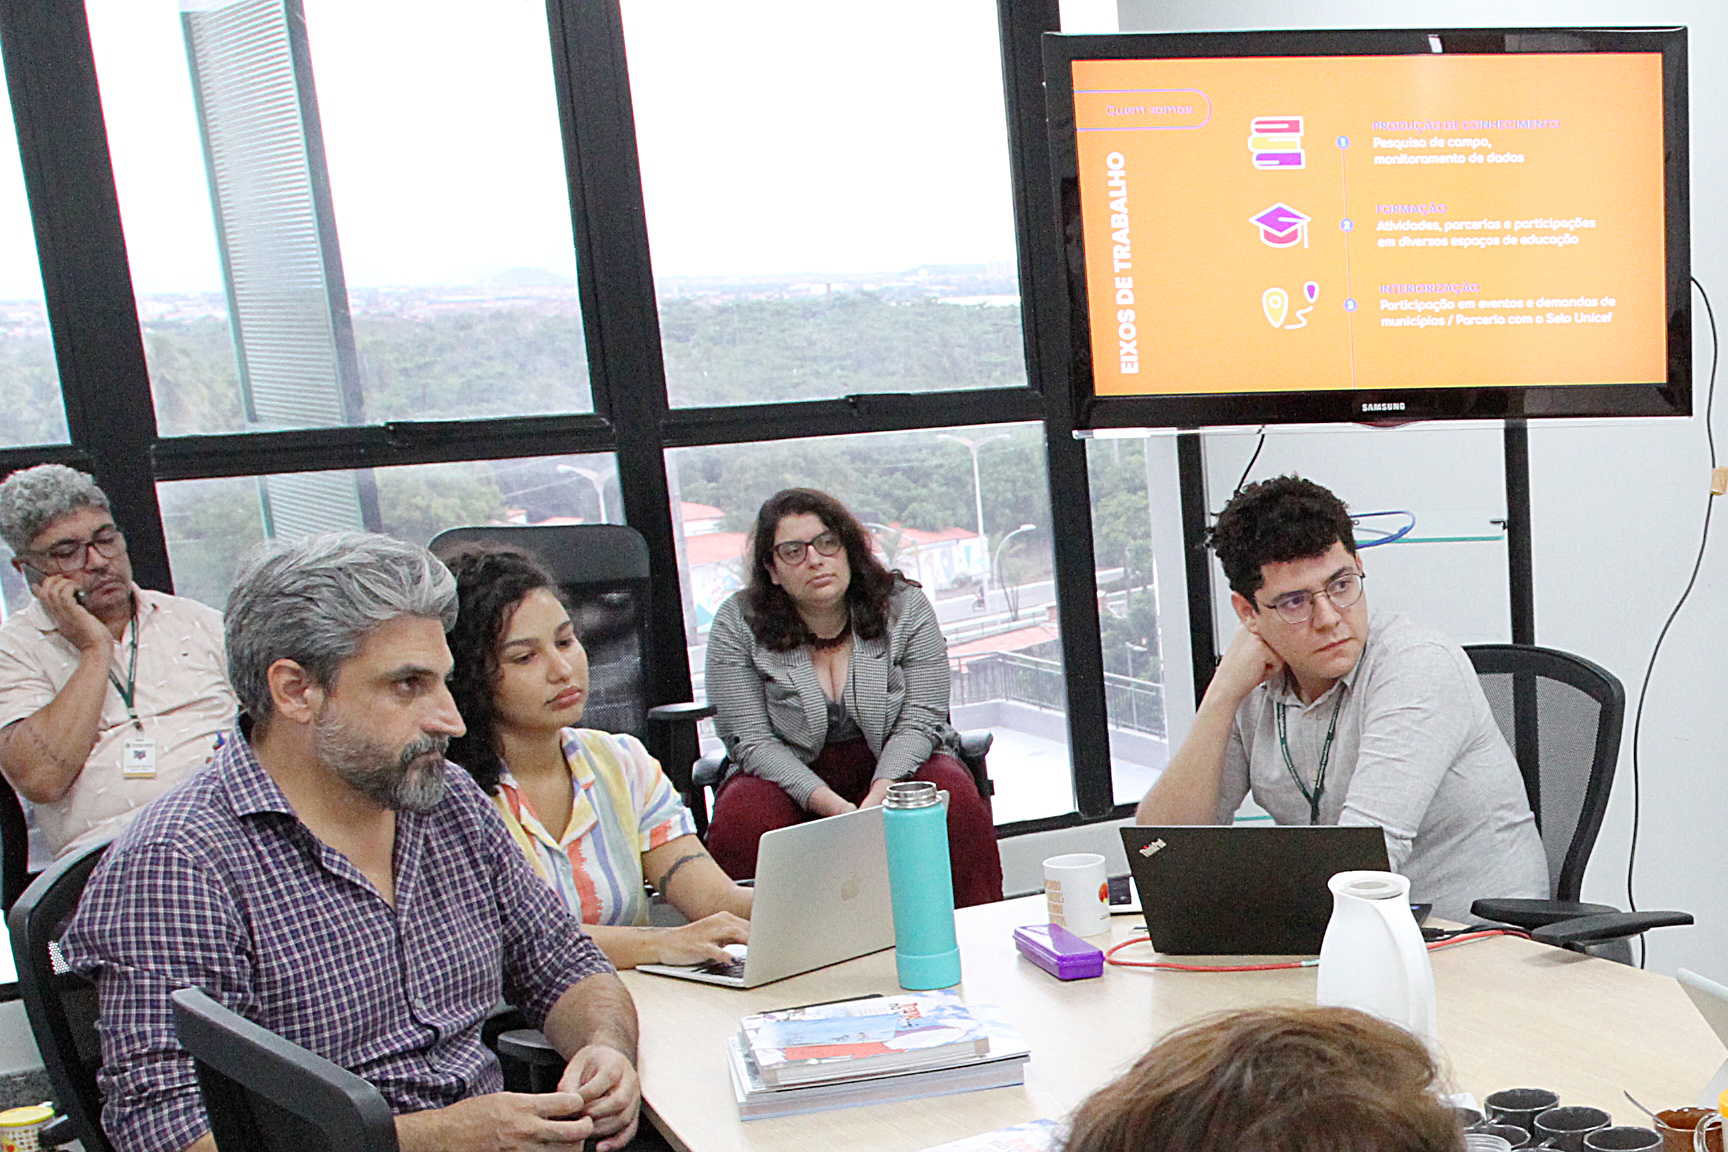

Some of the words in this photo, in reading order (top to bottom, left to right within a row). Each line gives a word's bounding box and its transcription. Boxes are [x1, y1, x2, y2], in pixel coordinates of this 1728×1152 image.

[1106, 104, 1146, 117] Quem
[1150, 104, 1194, 115] somos
[1372, 119, 1442, 133] PRODUÇÃO
[1444, 120, 1460, 131] DE
[1462, 119, 1561, 130] CONHECIMENTO
[1372, 136, 1427, 150] Pesquisa
[1429, 136, 1445, 148] de
[1448, 137, 1492, 149] campo,
[1374, 153, 1467, 165] monitoramento
[1468, 152, 1485, 164] de
[1486, 152, 1525, 164] dados
[1106, 151, 1132, 273] TRABALHO
[1376, 202, 1448, 217] FORMAÇÃO
[1376, 219, 1443, 233] Atividades,
[1444, 219, 1502, 232] parcerias
[1504, 220, 1512, 230] e
[1514, 217, 1597, 231] participações
[1377, 238, 1396, 248] em
[1398, 236, 1449, 247] diversos
[1450, 236, 1501, 249] espaços
[1502, 234, 1518, 246] de
[1520, 233, 1579, 247] educação
[1114, 276, 1135, 305] DE
[1379, 281, 1480, 296] INTERIORIZAÇÃO
[1379, 298, 1456, 313] Participação
[1458, 300, 1476, 310] em
[1478, 298, 1524, 310] eventos
[1526, 299, 1535, 309] e
[1536, 296, 1599, 309] demandas
[1600, 296, 1617, 308] de
[1380, 314, 1446, 328] municípios
[1448, 314, 1455, 327] /
[1456, 314, 1506, 326] Parceria
[1508, 314, 1533, 325] com
[1536, 314, 1544, 324] o
[1546, 312, 1572, 324] Selo
[1574, 312, 1613, 323] Unicef
[1116, 308, 1139, 374] EIXOS
[1362, 402, 1406, 412] SAMSUNG
